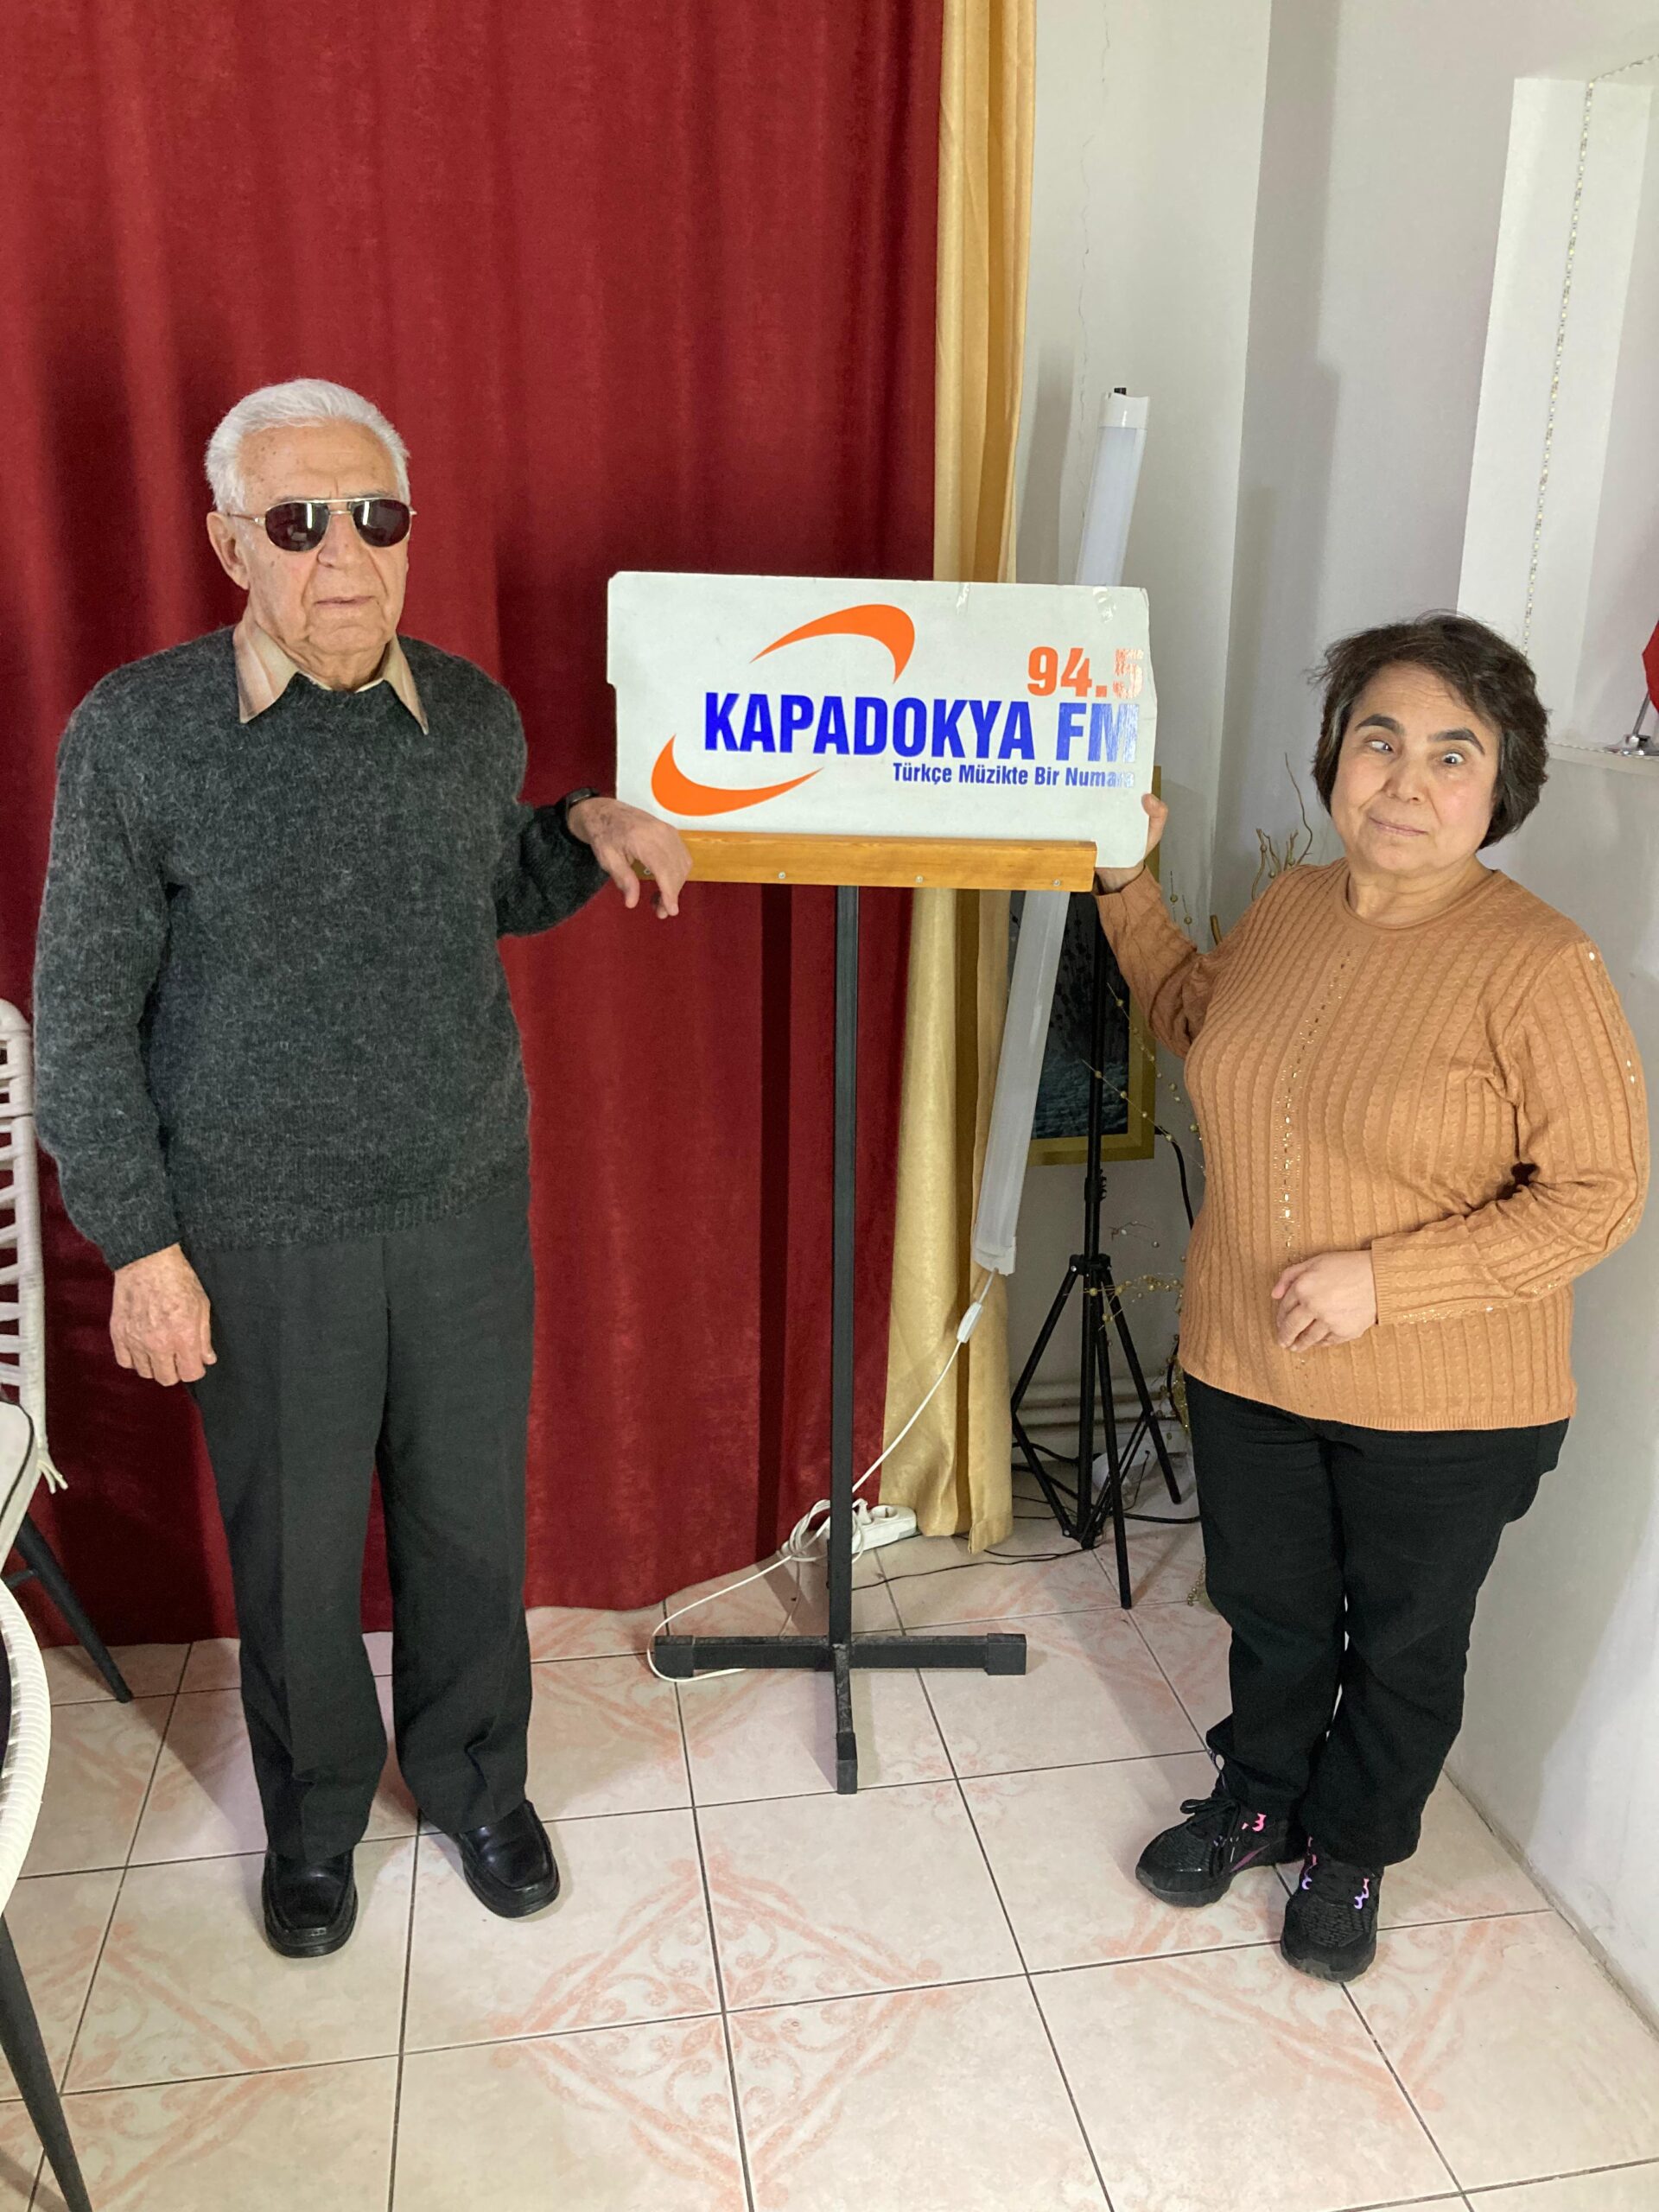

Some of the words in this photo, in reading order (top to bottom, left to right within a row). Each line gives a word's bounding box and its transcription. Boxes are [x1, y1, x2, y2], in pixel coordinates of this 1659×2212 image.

[1027, 646, 1144, 699] 94.5
[704, 692, 1035, 760] KAPADOKYA
[1056, 702, 1140, 763] FM
[893, 762, 952, 785] Türkçe
[958, 764, 1028, 785] Müzikte
[1034, 766, 1059, 785] Bir
[1065, 766, 1135, 788] Numara
